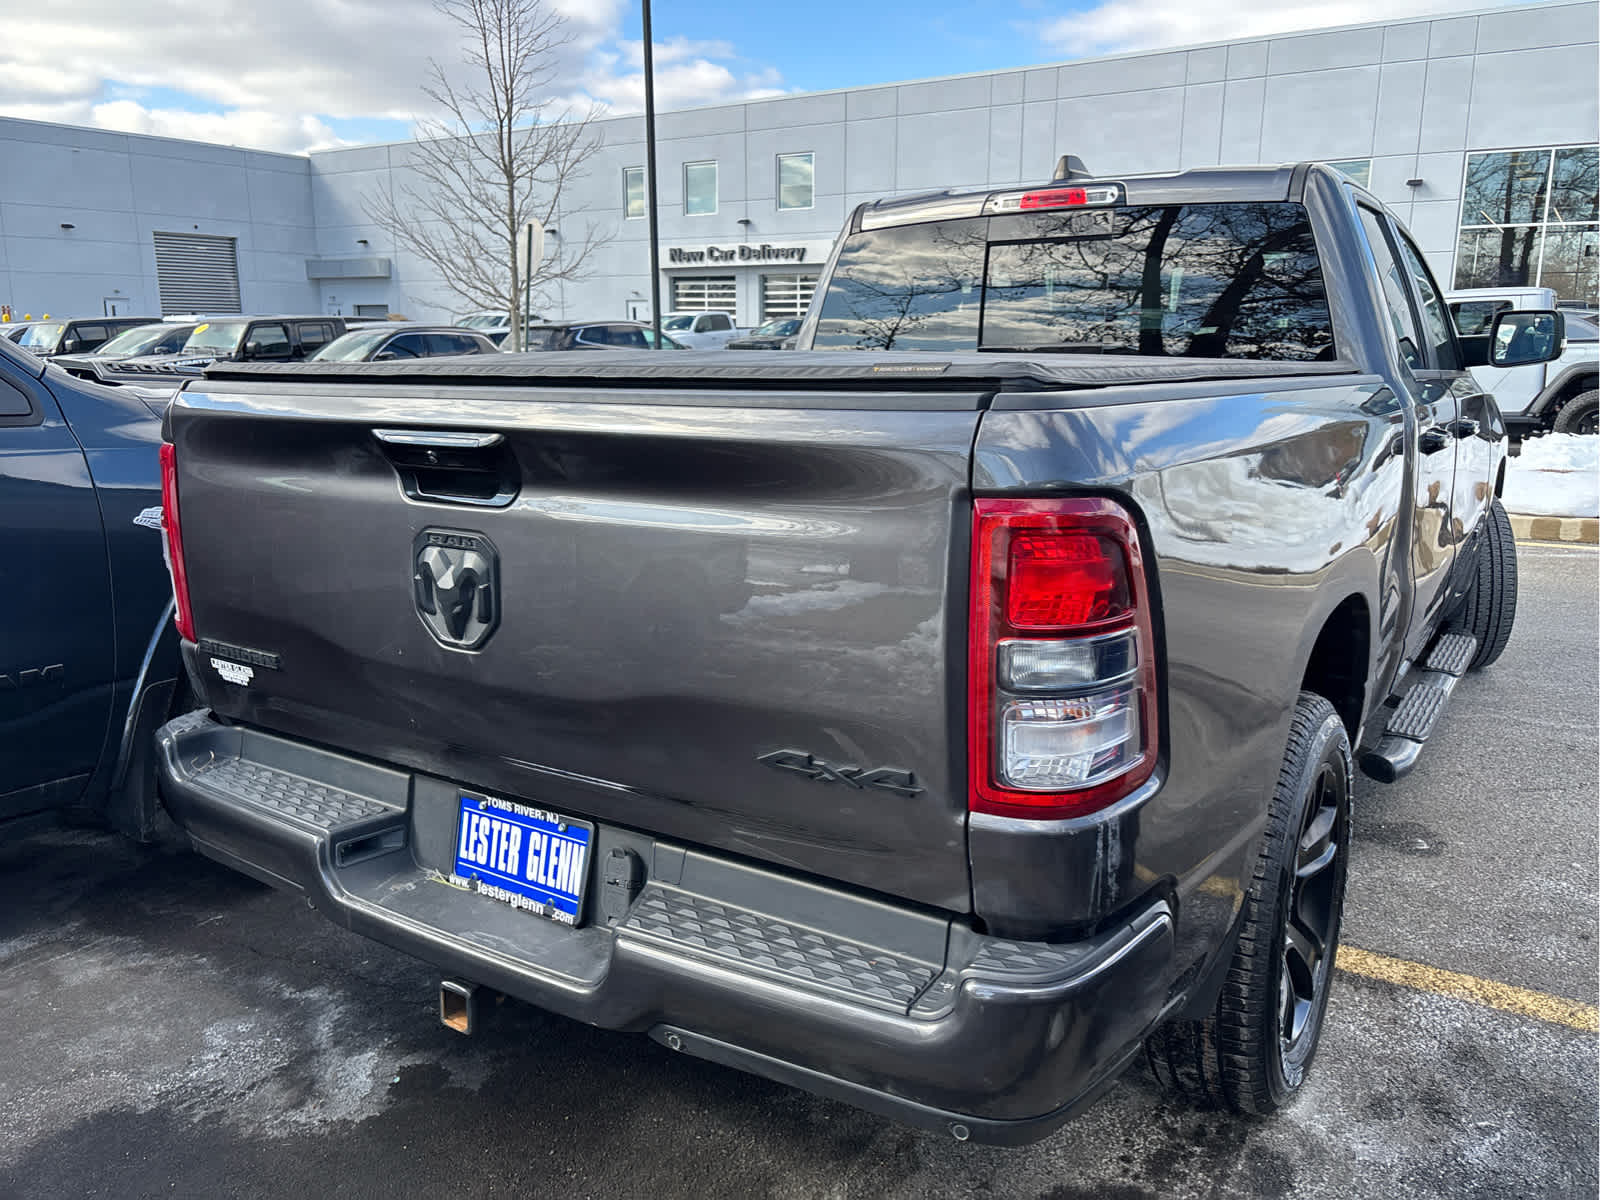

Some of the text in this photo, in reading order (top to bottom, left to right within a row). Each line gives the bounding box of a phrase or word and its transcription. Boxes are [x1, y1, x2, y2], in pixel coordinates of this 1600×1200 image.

[669, 244, 807, 263] New Car Delivery
[427, 532, 477, 549] RAM
[486, 796, 513, 813] TOMS
[546, 812, 559, 825] NJ
[458, 811, 586, 897] LESTER GLENN
